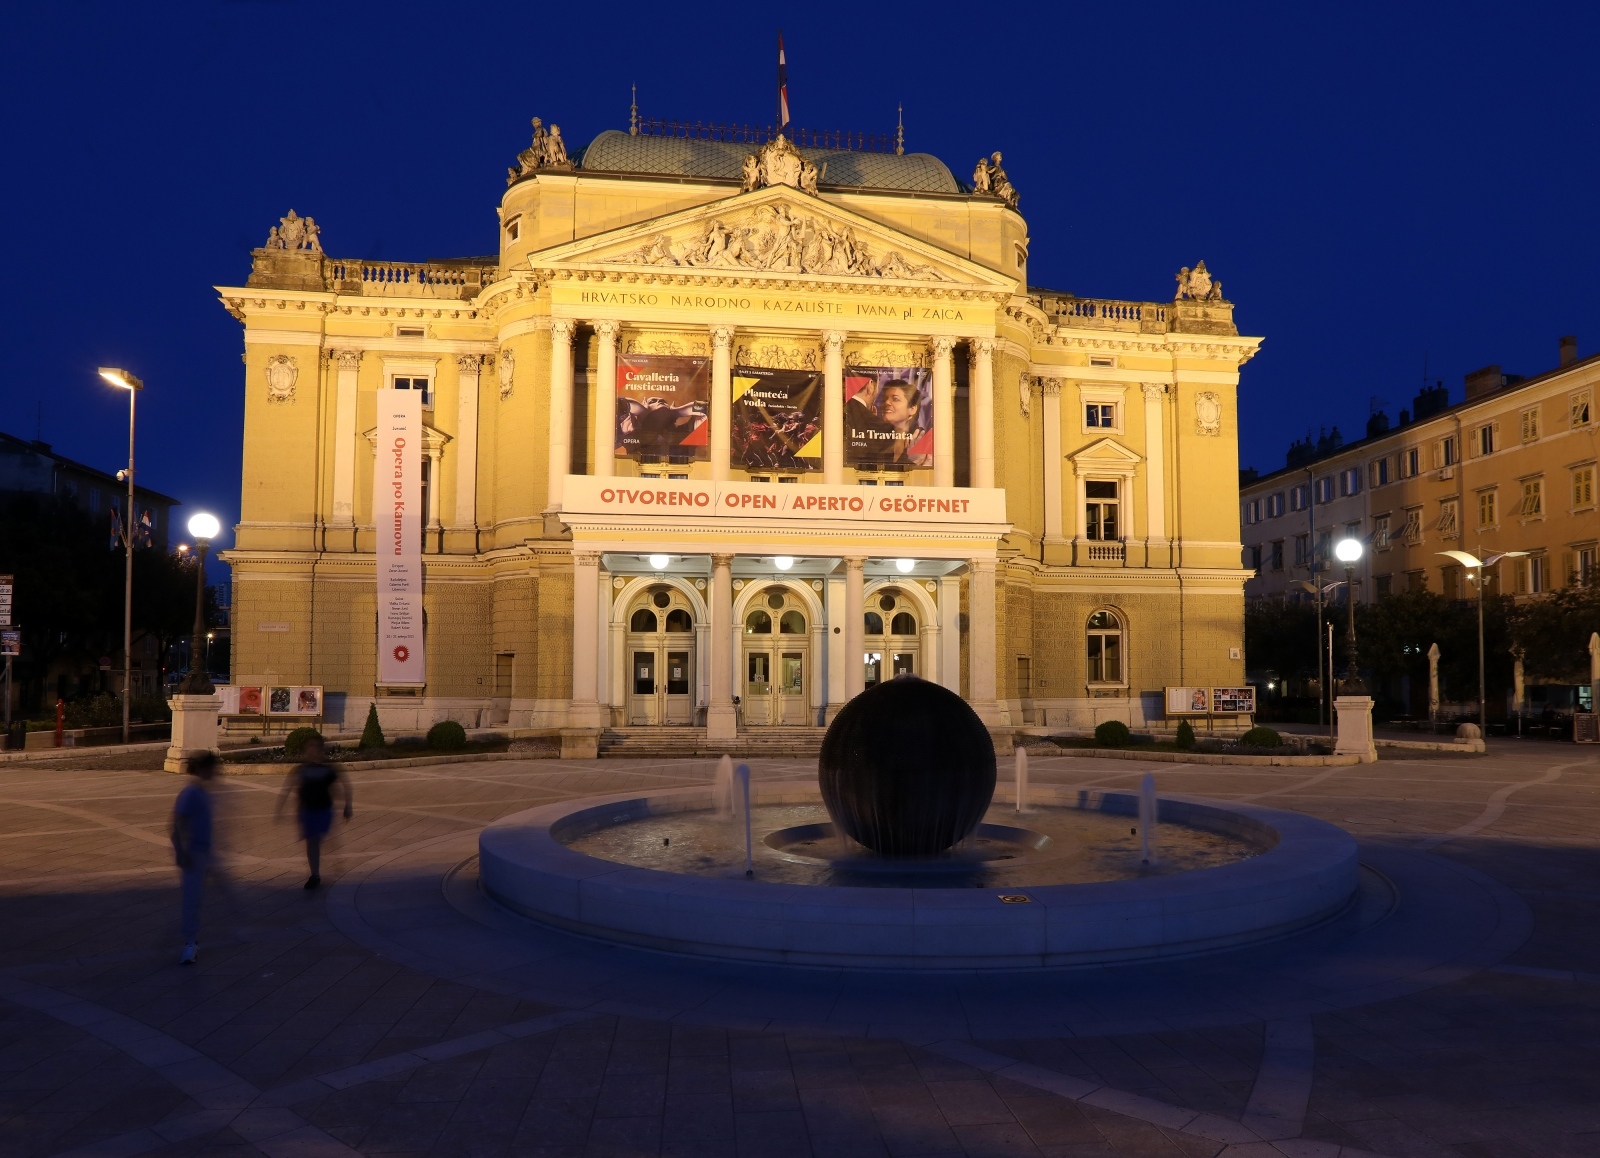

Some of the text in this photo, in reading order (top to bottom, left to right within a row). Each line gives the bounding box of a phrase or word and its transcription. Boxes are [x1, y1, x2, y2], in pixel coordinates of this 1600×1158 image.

[581, 292, 658, 306] HRVATSKO
[671, 295, 751, 309] NARODNO
[763, 299, 843, 314] KAZALIŠTE
[857, 304, 897, 317] IVANA
[922, 308, 963, 320] ZAJCA
[625, 371, 680, 382] Cavalleria
[625, 382, 676, 392] rusticana
[744, 388, 788, 399] Plamteća
[744, 398, 766, 408] voda
[852, 428, 914, 440] La Traviata
[392, 437, 406, 478] Opera
[392, 482, 402, 499] po
[600, 488, 710, 506] OTVORENO
[724, 494, 776, 508] OPEN
[792, 496, 863, 512] APERTO
[879, 495, 970, 513] GEÖFFNET
[394, 502, 404, 556] Kamovu
